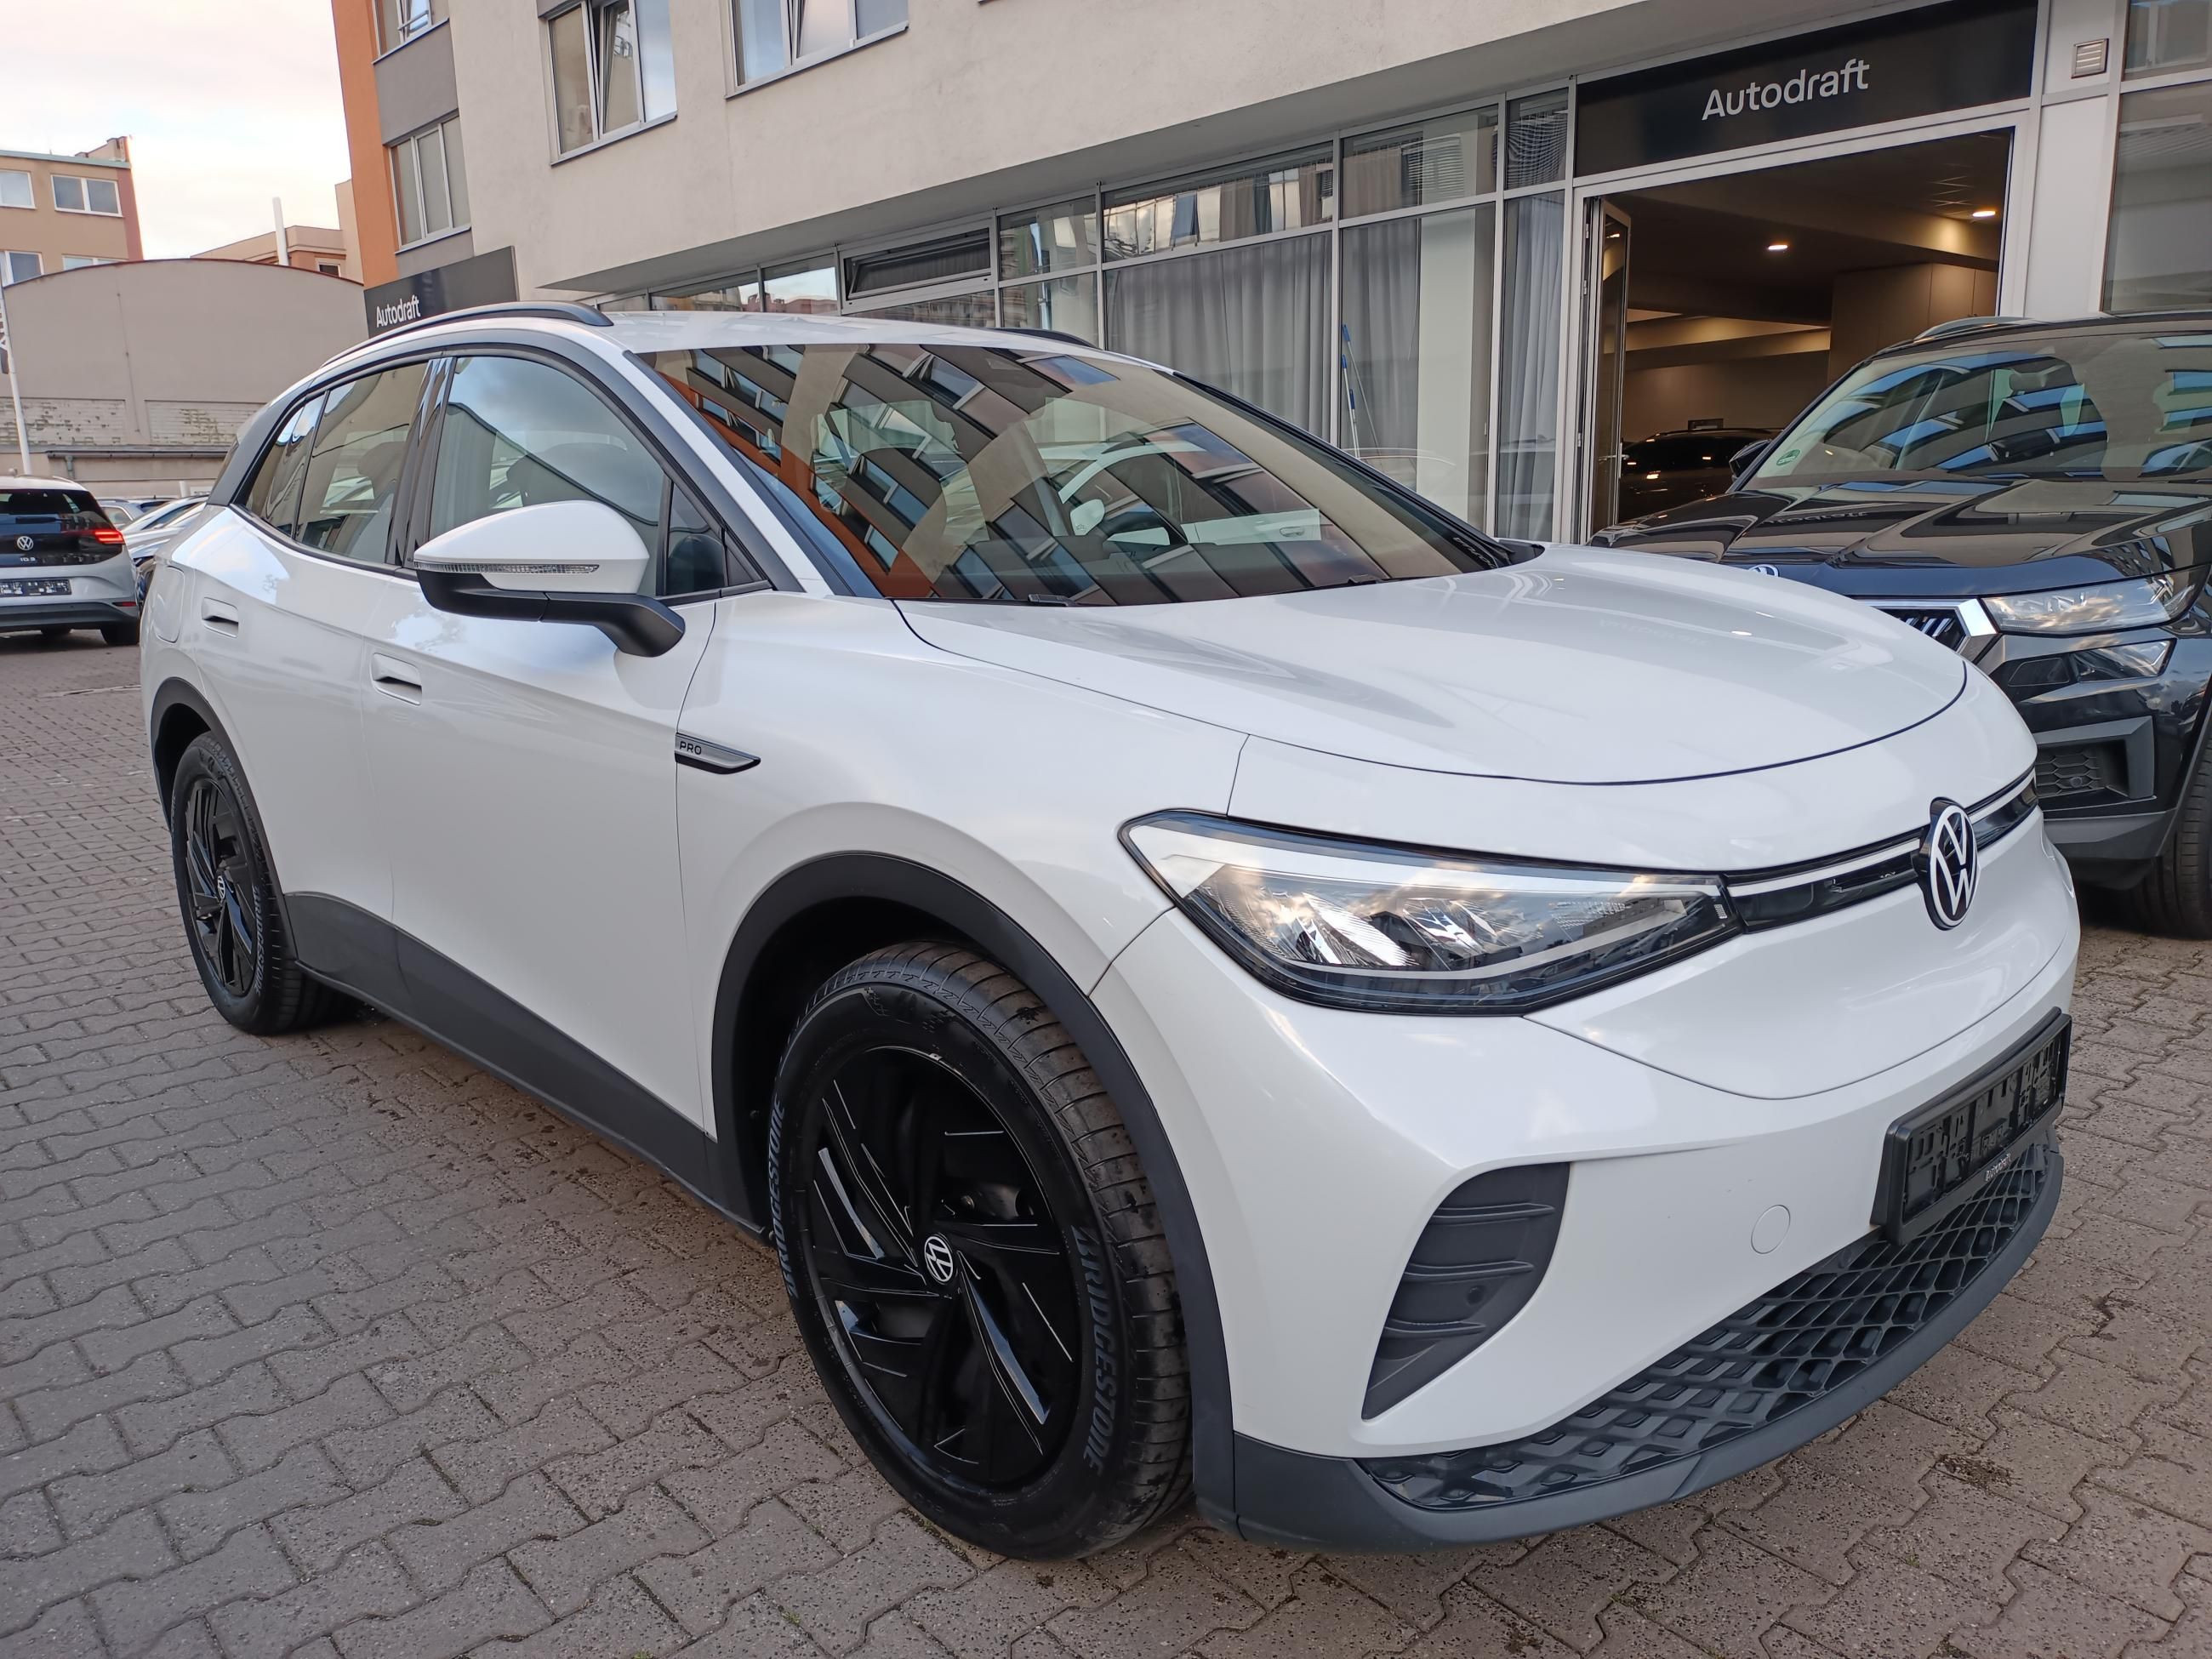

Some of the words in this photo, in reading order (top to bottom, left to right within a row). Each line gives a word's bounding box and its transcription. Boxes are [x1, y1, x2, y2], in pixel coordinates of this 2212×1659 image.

[1702, 58, 1870, 121] Autodraft
[376, 294, 421, 328] Autodraft
[680, 741, 702, 755] PRO
[1070, 1224, 1116, 1477] BRIDGESTONE
